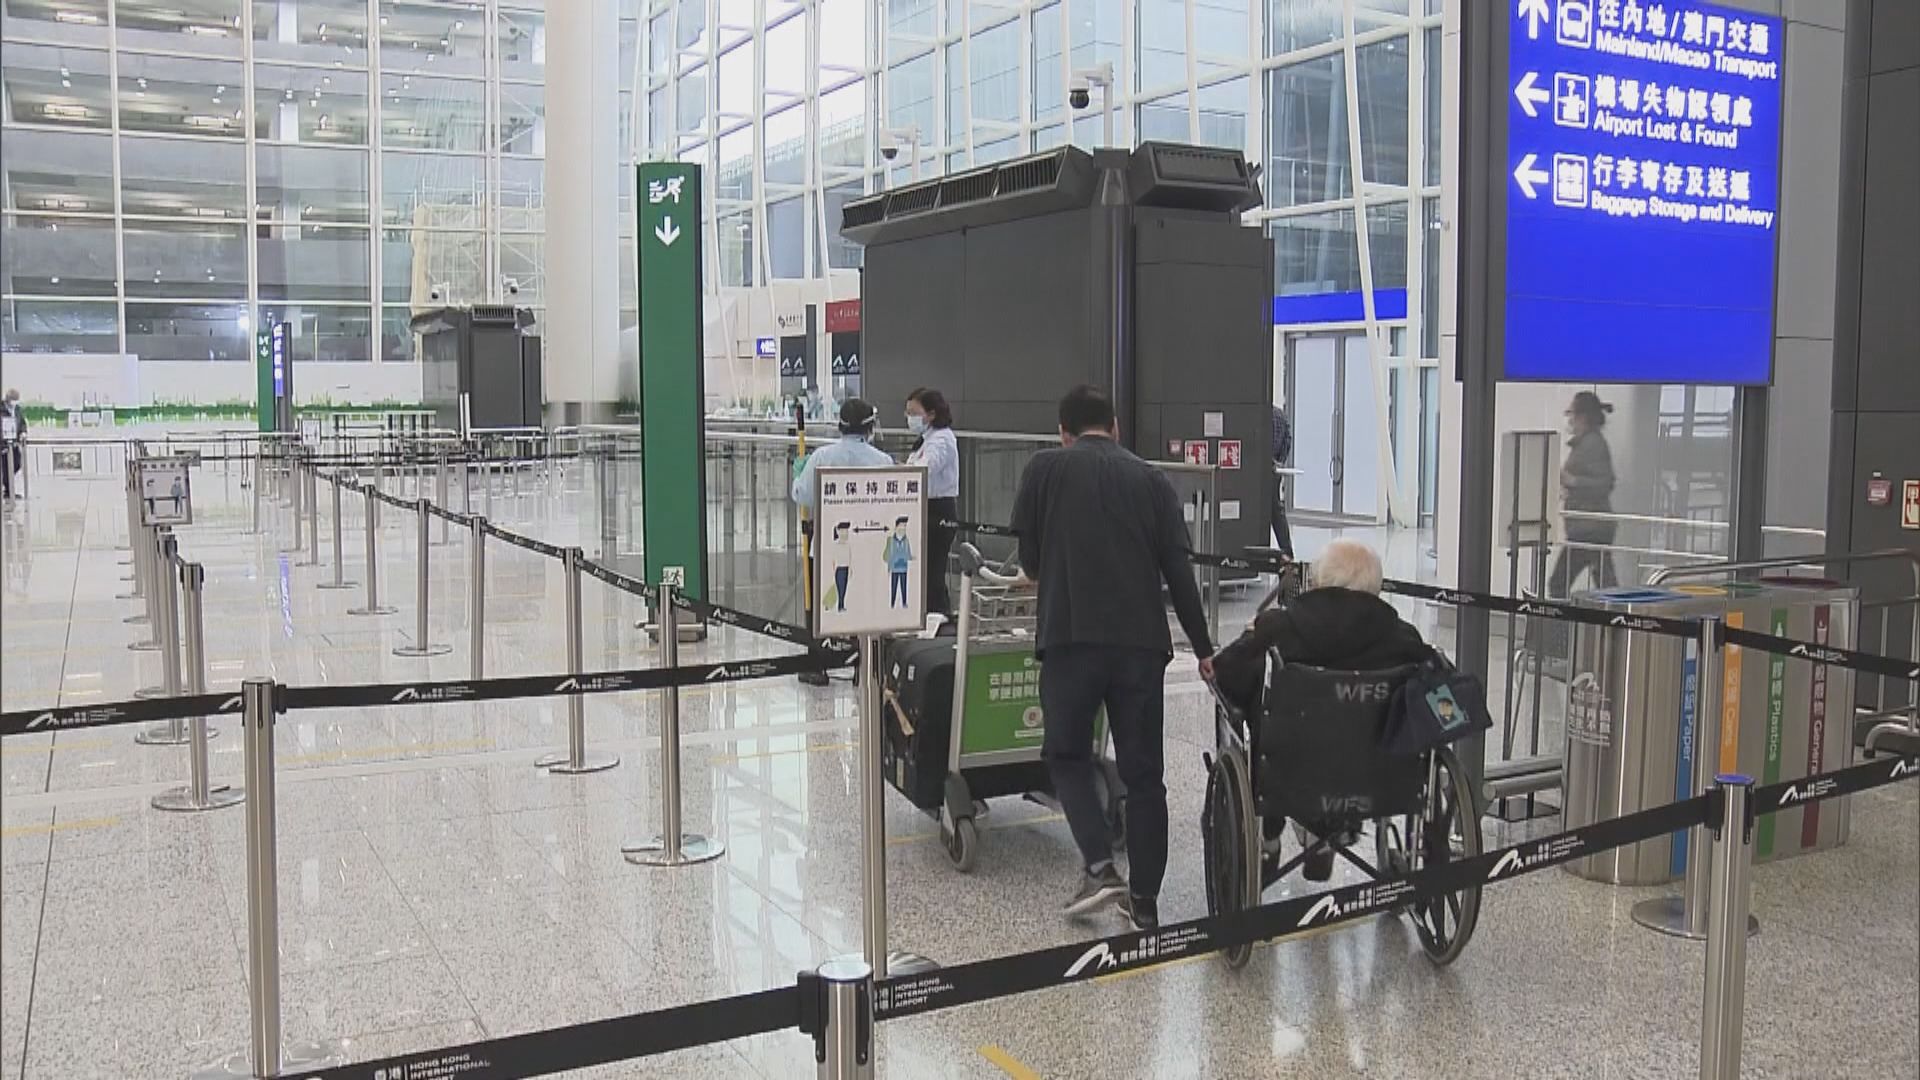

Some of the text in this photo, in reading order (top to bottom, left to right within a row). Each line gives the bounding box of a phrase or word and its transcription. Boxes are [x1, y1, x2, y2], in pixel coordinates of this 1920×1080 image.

[1596, 29, 1777, 80] Mainland/Macao Transport
[1593, 110, 1738, 149] Airport Lost & Found
[1591, 190, 1774, 229] Baggage Storage and Delivery
[1335, 682, 1390, 701] WFS
[1682, 714, 1695, 761] Paper
[1769, 700, 1782, 762] Plastics
[1811, 719, 1823, 775] Genera
[1320, 796, 1371, 812] WFS
[895, 978, 940, 991] HONG KONG
[895, 983, 954, 1000] INTERNATIONAL
[895, 997, 927, 1008] AIRPORT
[410, 1055, 470, 1070] HONG KONG
[411, 1060, 490, 1080] INTERNATIONAL
